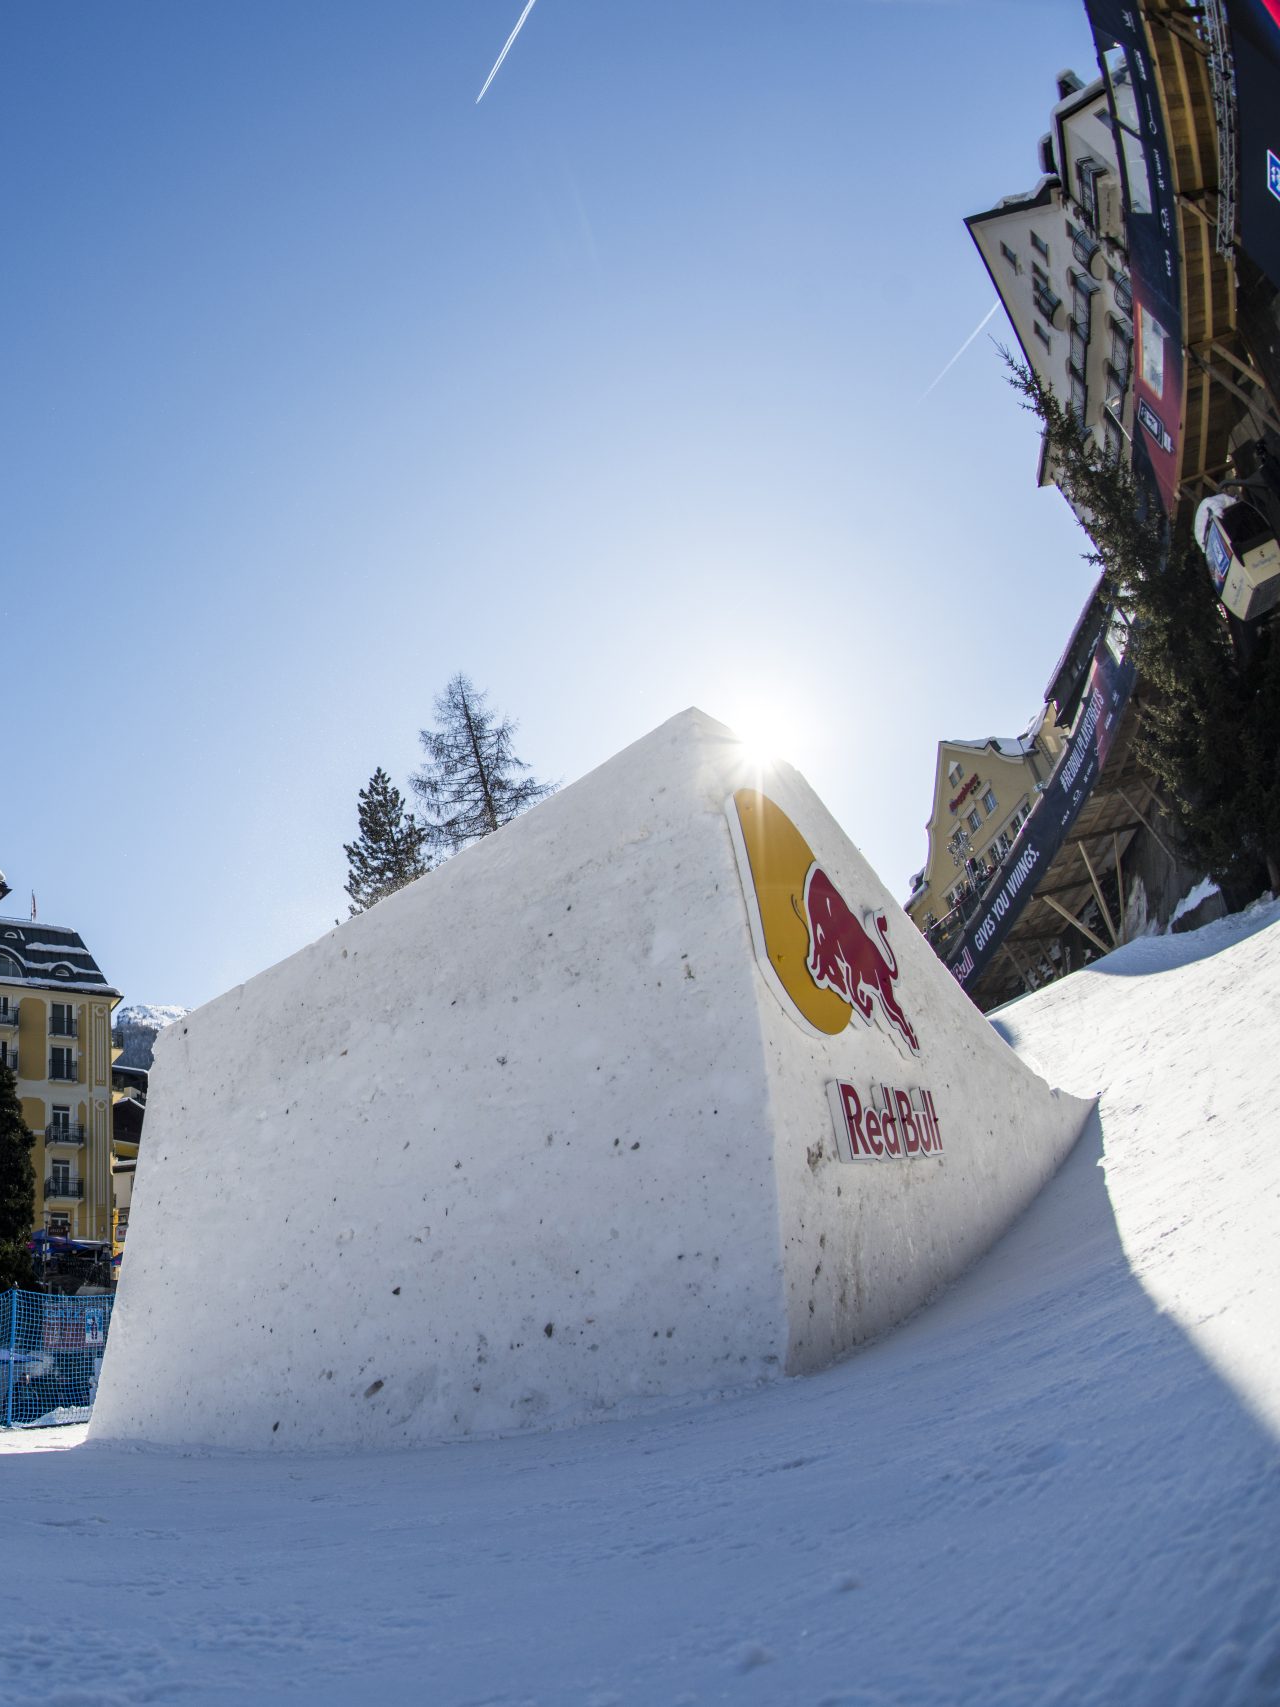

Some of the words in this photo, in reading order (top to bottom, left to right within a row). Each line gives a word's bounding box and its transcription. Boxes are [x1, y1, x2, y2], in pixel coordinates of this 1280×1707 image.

[974, 913, 996, 952] GIVES
[991, 889, 1010, 922] YOU
[839, 1083, 902, 1156] Red
[894, 1086, 943, 1153] Bull
